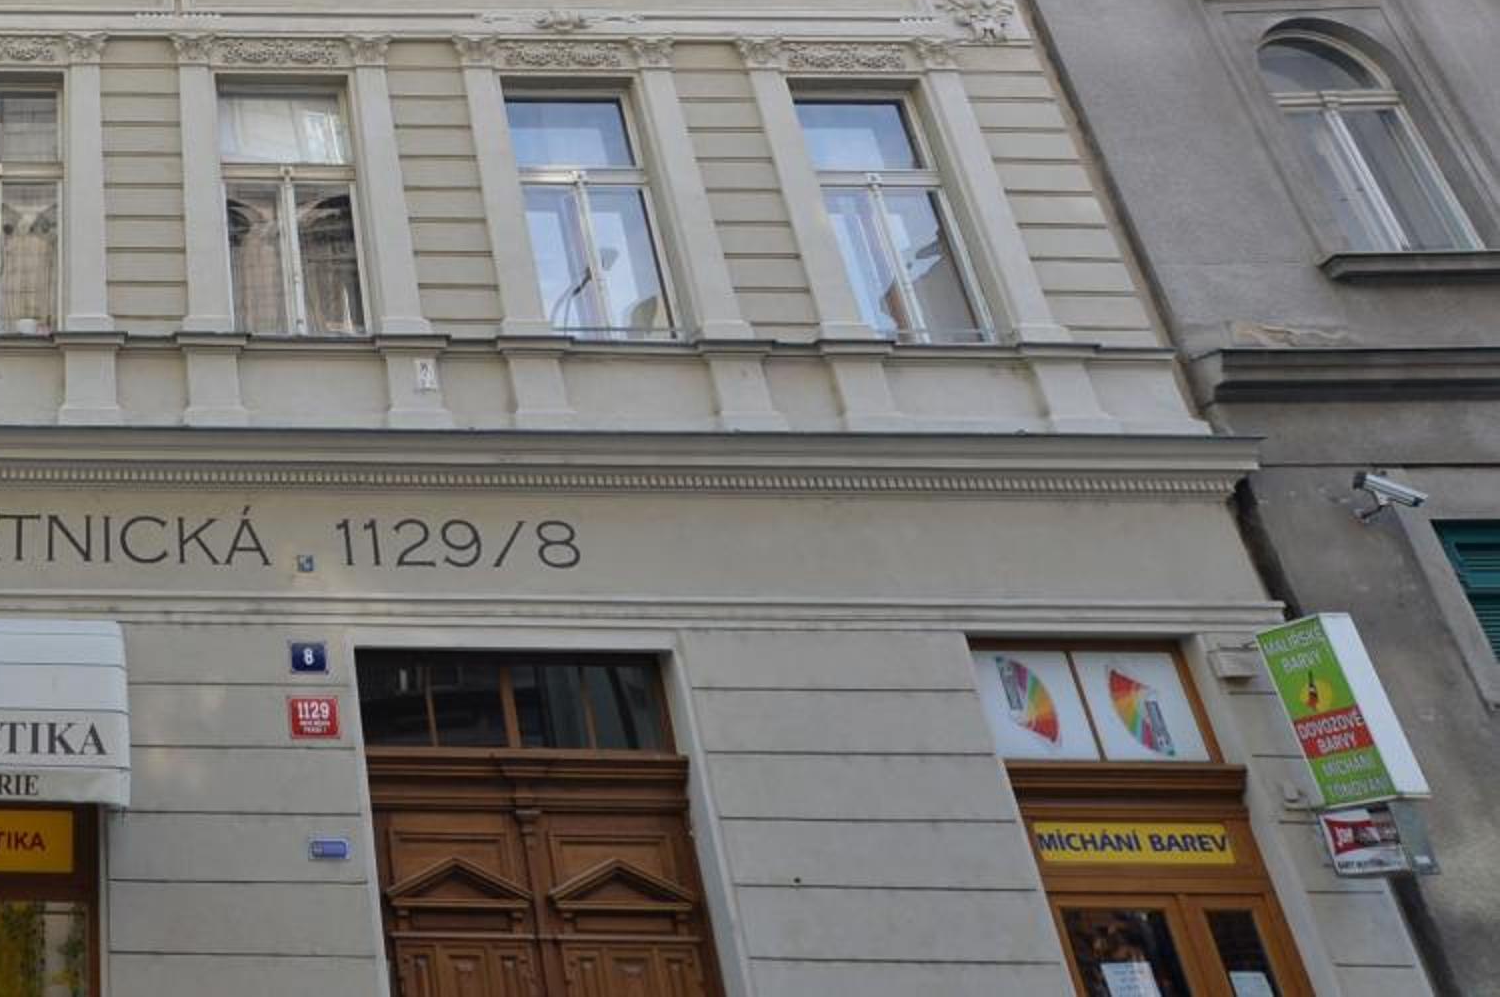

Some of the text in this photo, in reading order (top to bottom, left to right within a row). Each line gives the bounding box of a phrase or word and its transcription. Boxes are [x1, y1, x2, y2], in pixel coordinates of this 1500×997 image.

[335, 518, 581, 569] 1129/8
[303, 647, 315, 666] 8
[297, 701, 330, 720] 1129
[1316, 732, 1357, 754] BARVY
[1037, 829, 1227, 853] MÍCHÁNÍ BAREV
